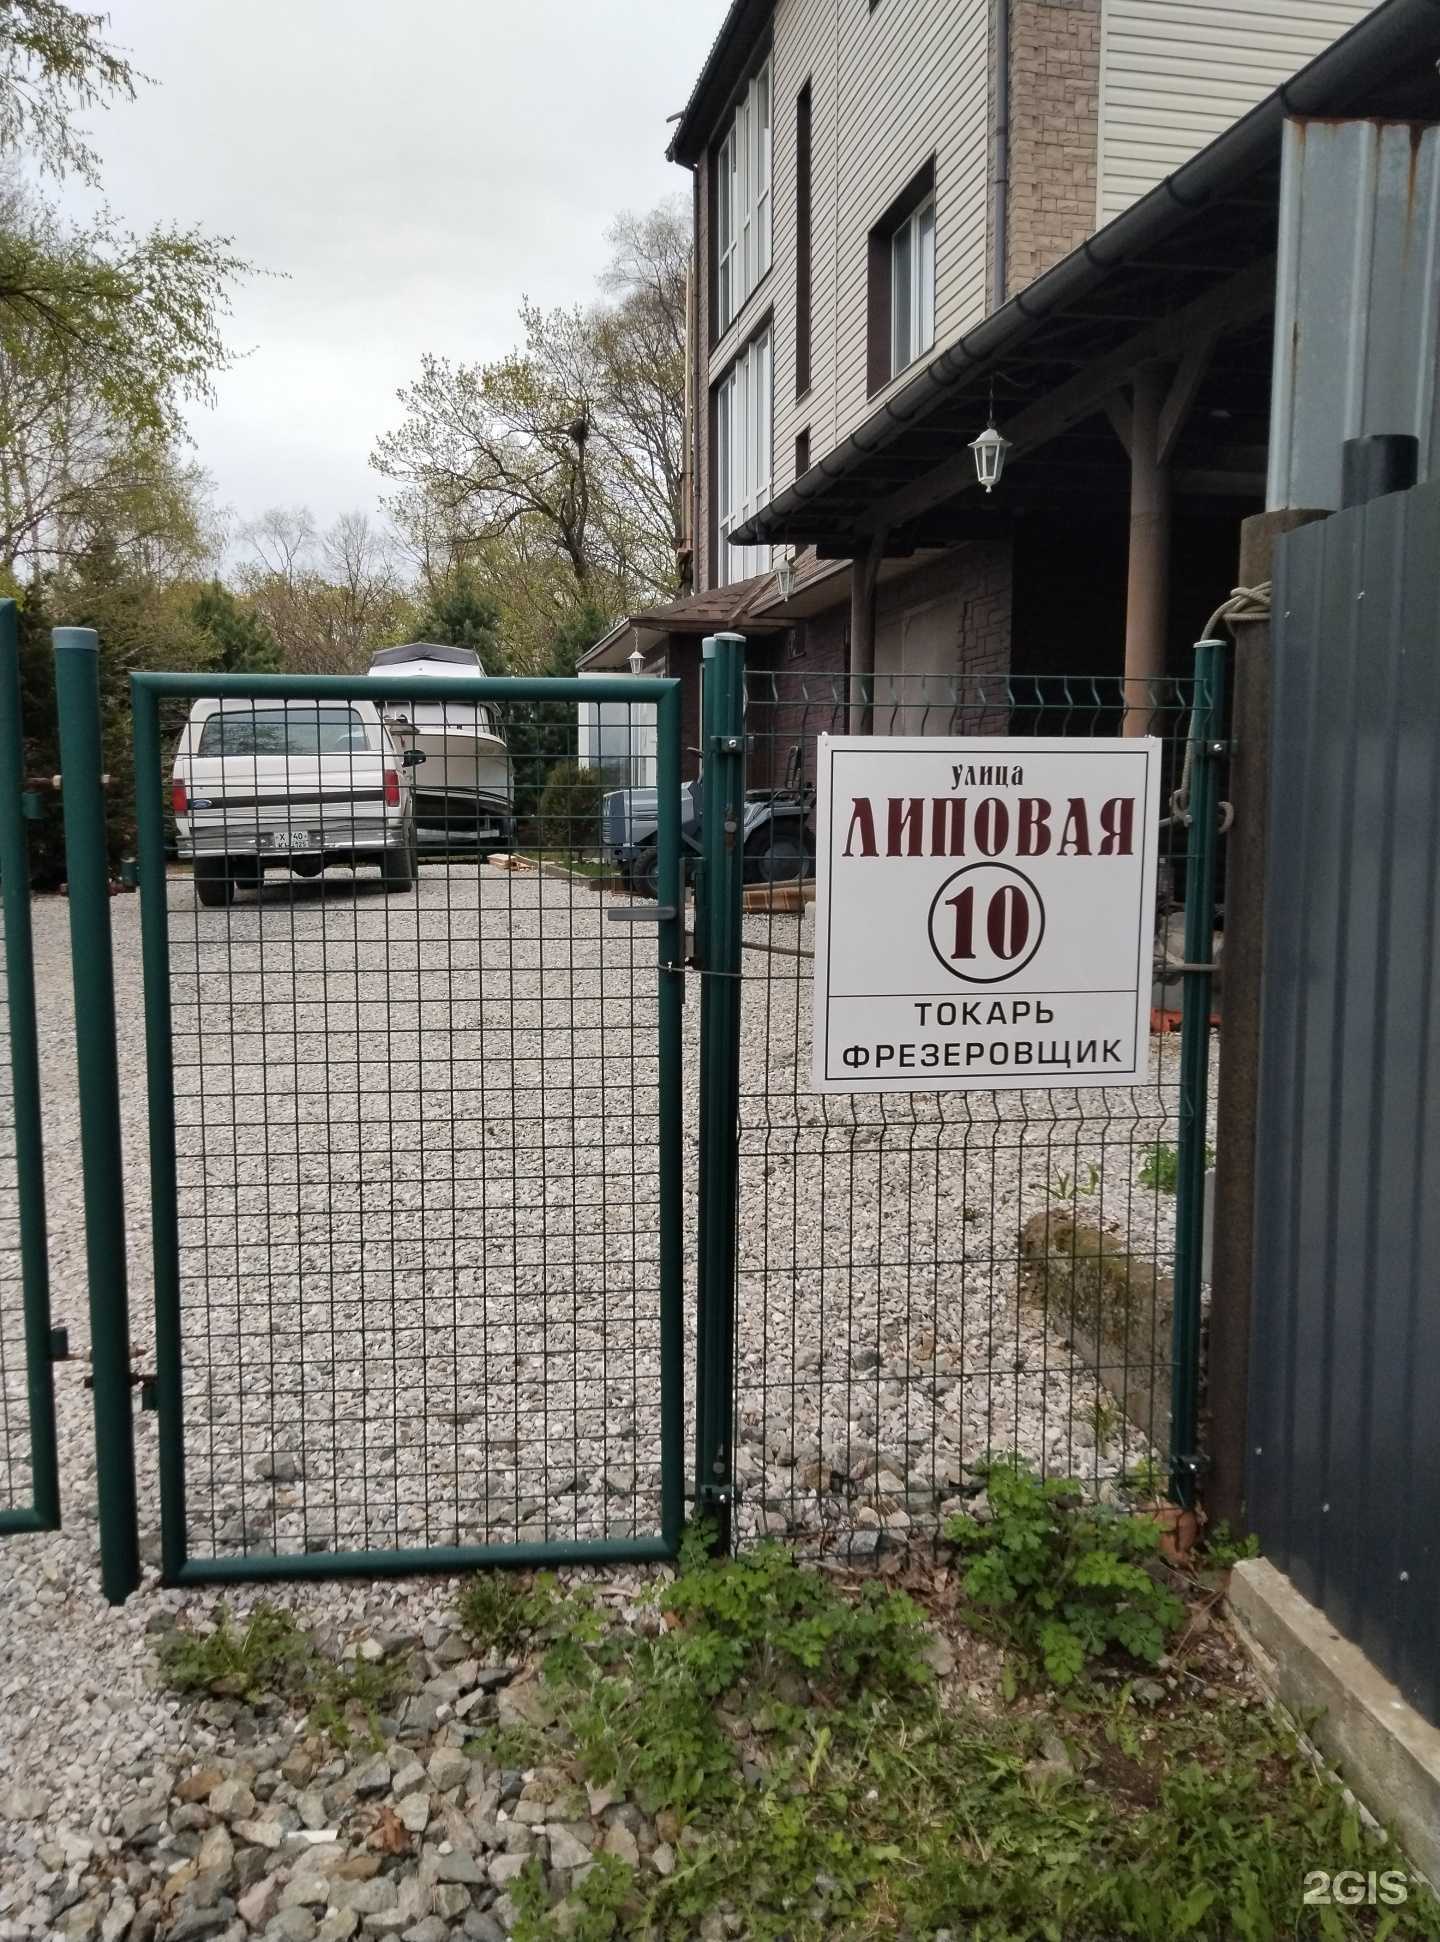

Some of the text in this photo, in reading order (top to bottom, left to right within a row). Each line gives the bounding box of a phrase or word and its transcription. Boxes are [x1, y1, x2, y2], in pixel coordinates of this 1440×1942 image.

[951, 764, 1024, 790] улица
[841, 797, 1136, 857] ЛИПОВАЯ
[945, 885, 1029, 960] 10
[914, 1001, 1055, 1026] ТОКАРЬ
[842, 1039, 1122, 1069] ФРЕЗЕРОВЩИК
